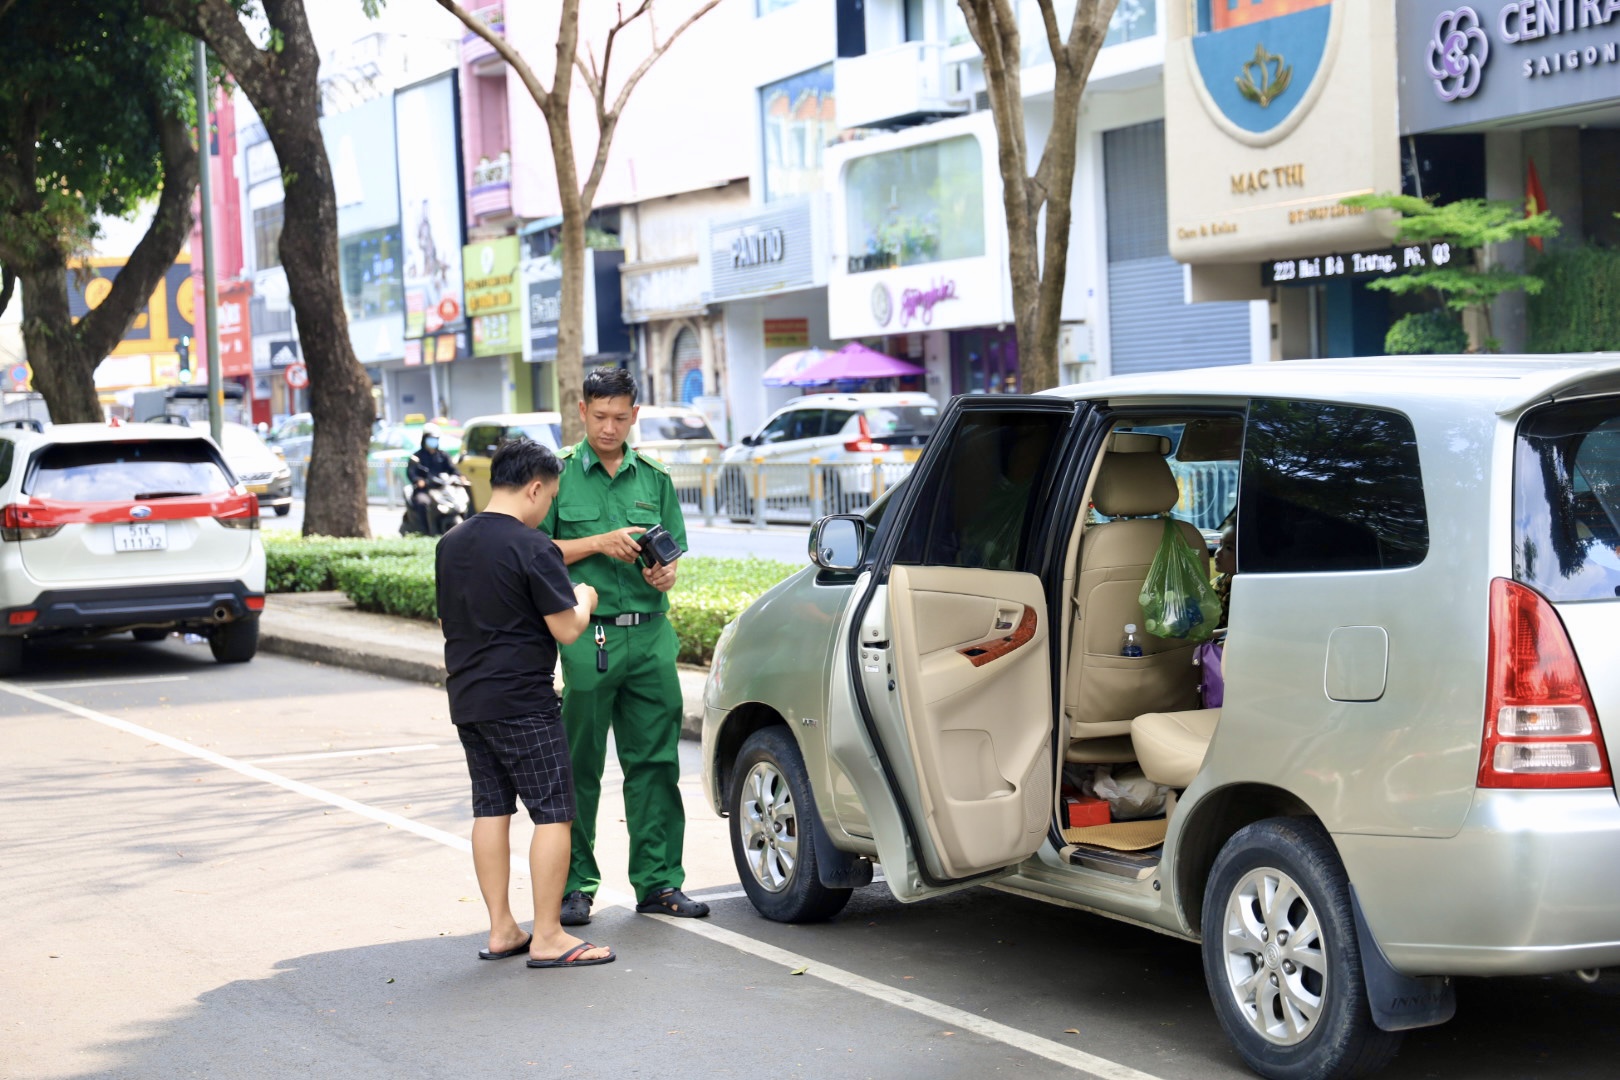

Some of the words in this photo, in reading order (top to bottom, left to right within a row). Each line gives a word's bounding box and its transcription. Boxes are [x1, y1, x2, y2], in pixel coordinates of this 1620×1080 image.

[1521, 41, 1617, 78] SAIGON
[1273, 260, 1296, 282] 223
[1298, 257, 1321, 279] Hai
[1324, 255, 1345, 277] Bà
[1431, 242, 1450, 266] Q3
